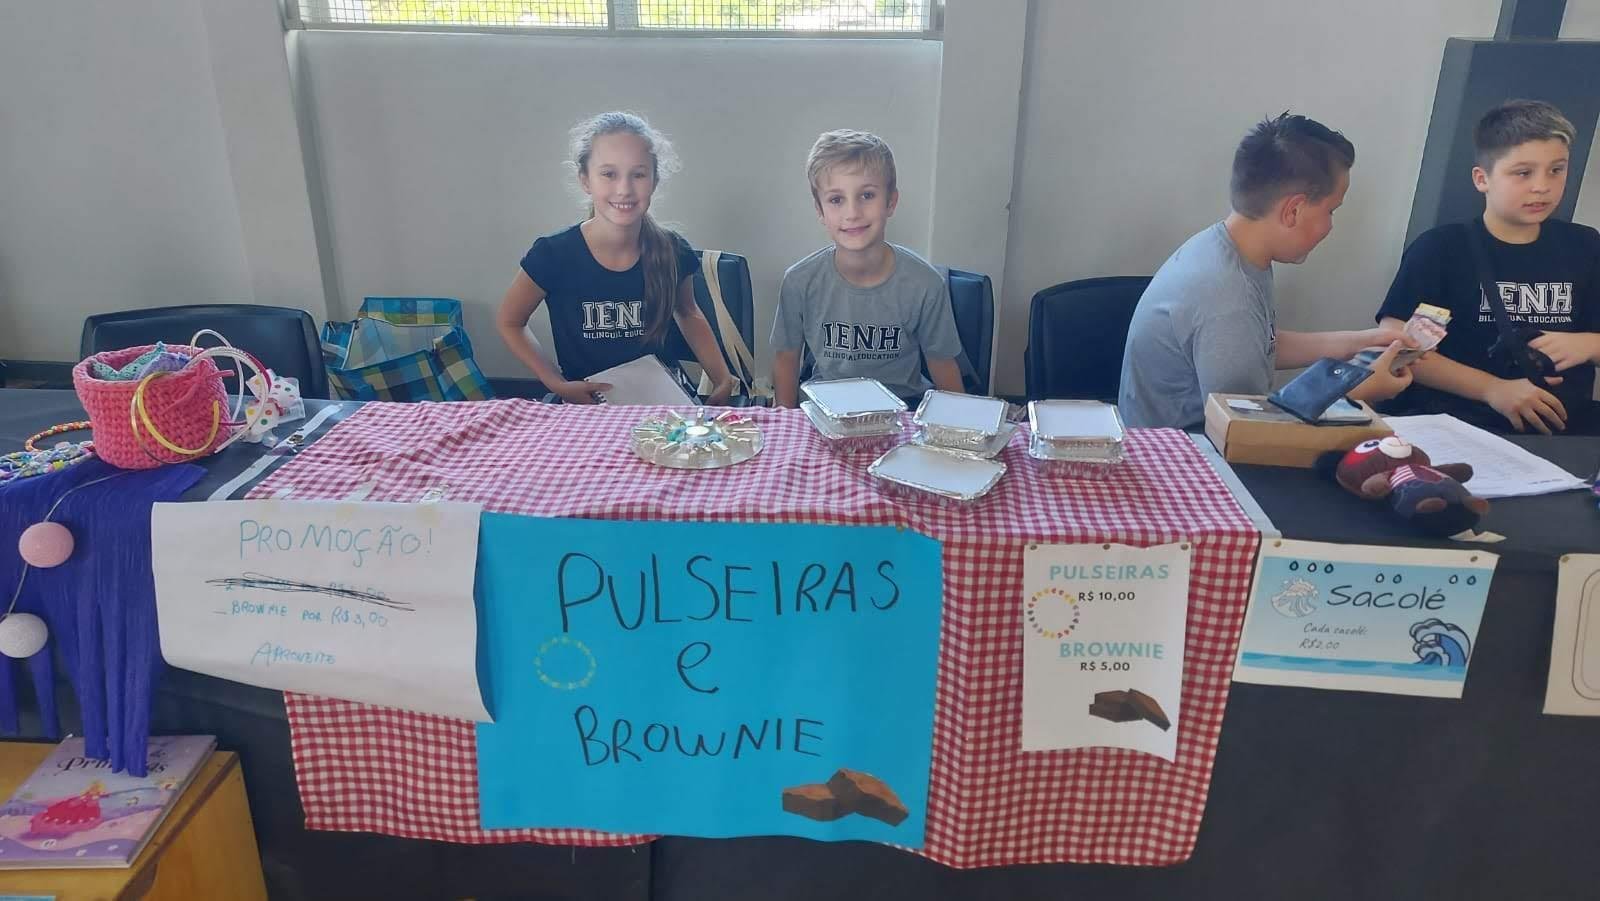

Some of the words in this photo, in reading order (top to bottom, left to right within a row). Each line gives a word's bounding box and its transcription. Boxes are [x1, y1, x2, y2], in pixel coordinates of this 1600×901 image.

[582, 301, 645, 330] IEN
[1528, 315, 1572, 324] EDUCATION
[823, 321, 901, 351] IENH
[857, 352, 900, 360] EDUCATION
[239, 519, 433, 567] PROMOÇÃO!
[1049, 564, 1169, 581] PULSEIRAS
[557, 552, 899, 633] PULSEIRAS
[1078, 590, 1094, 602] R$
[1327, 584, 1447, 611] Sacolé
[1303, 622, 1330, 633] Cada
[1059, 642, 1164, 660] BROWNIE
[1080, 660, 1096, 672] R$
[574, 704, 824, 766] BROWNIE
